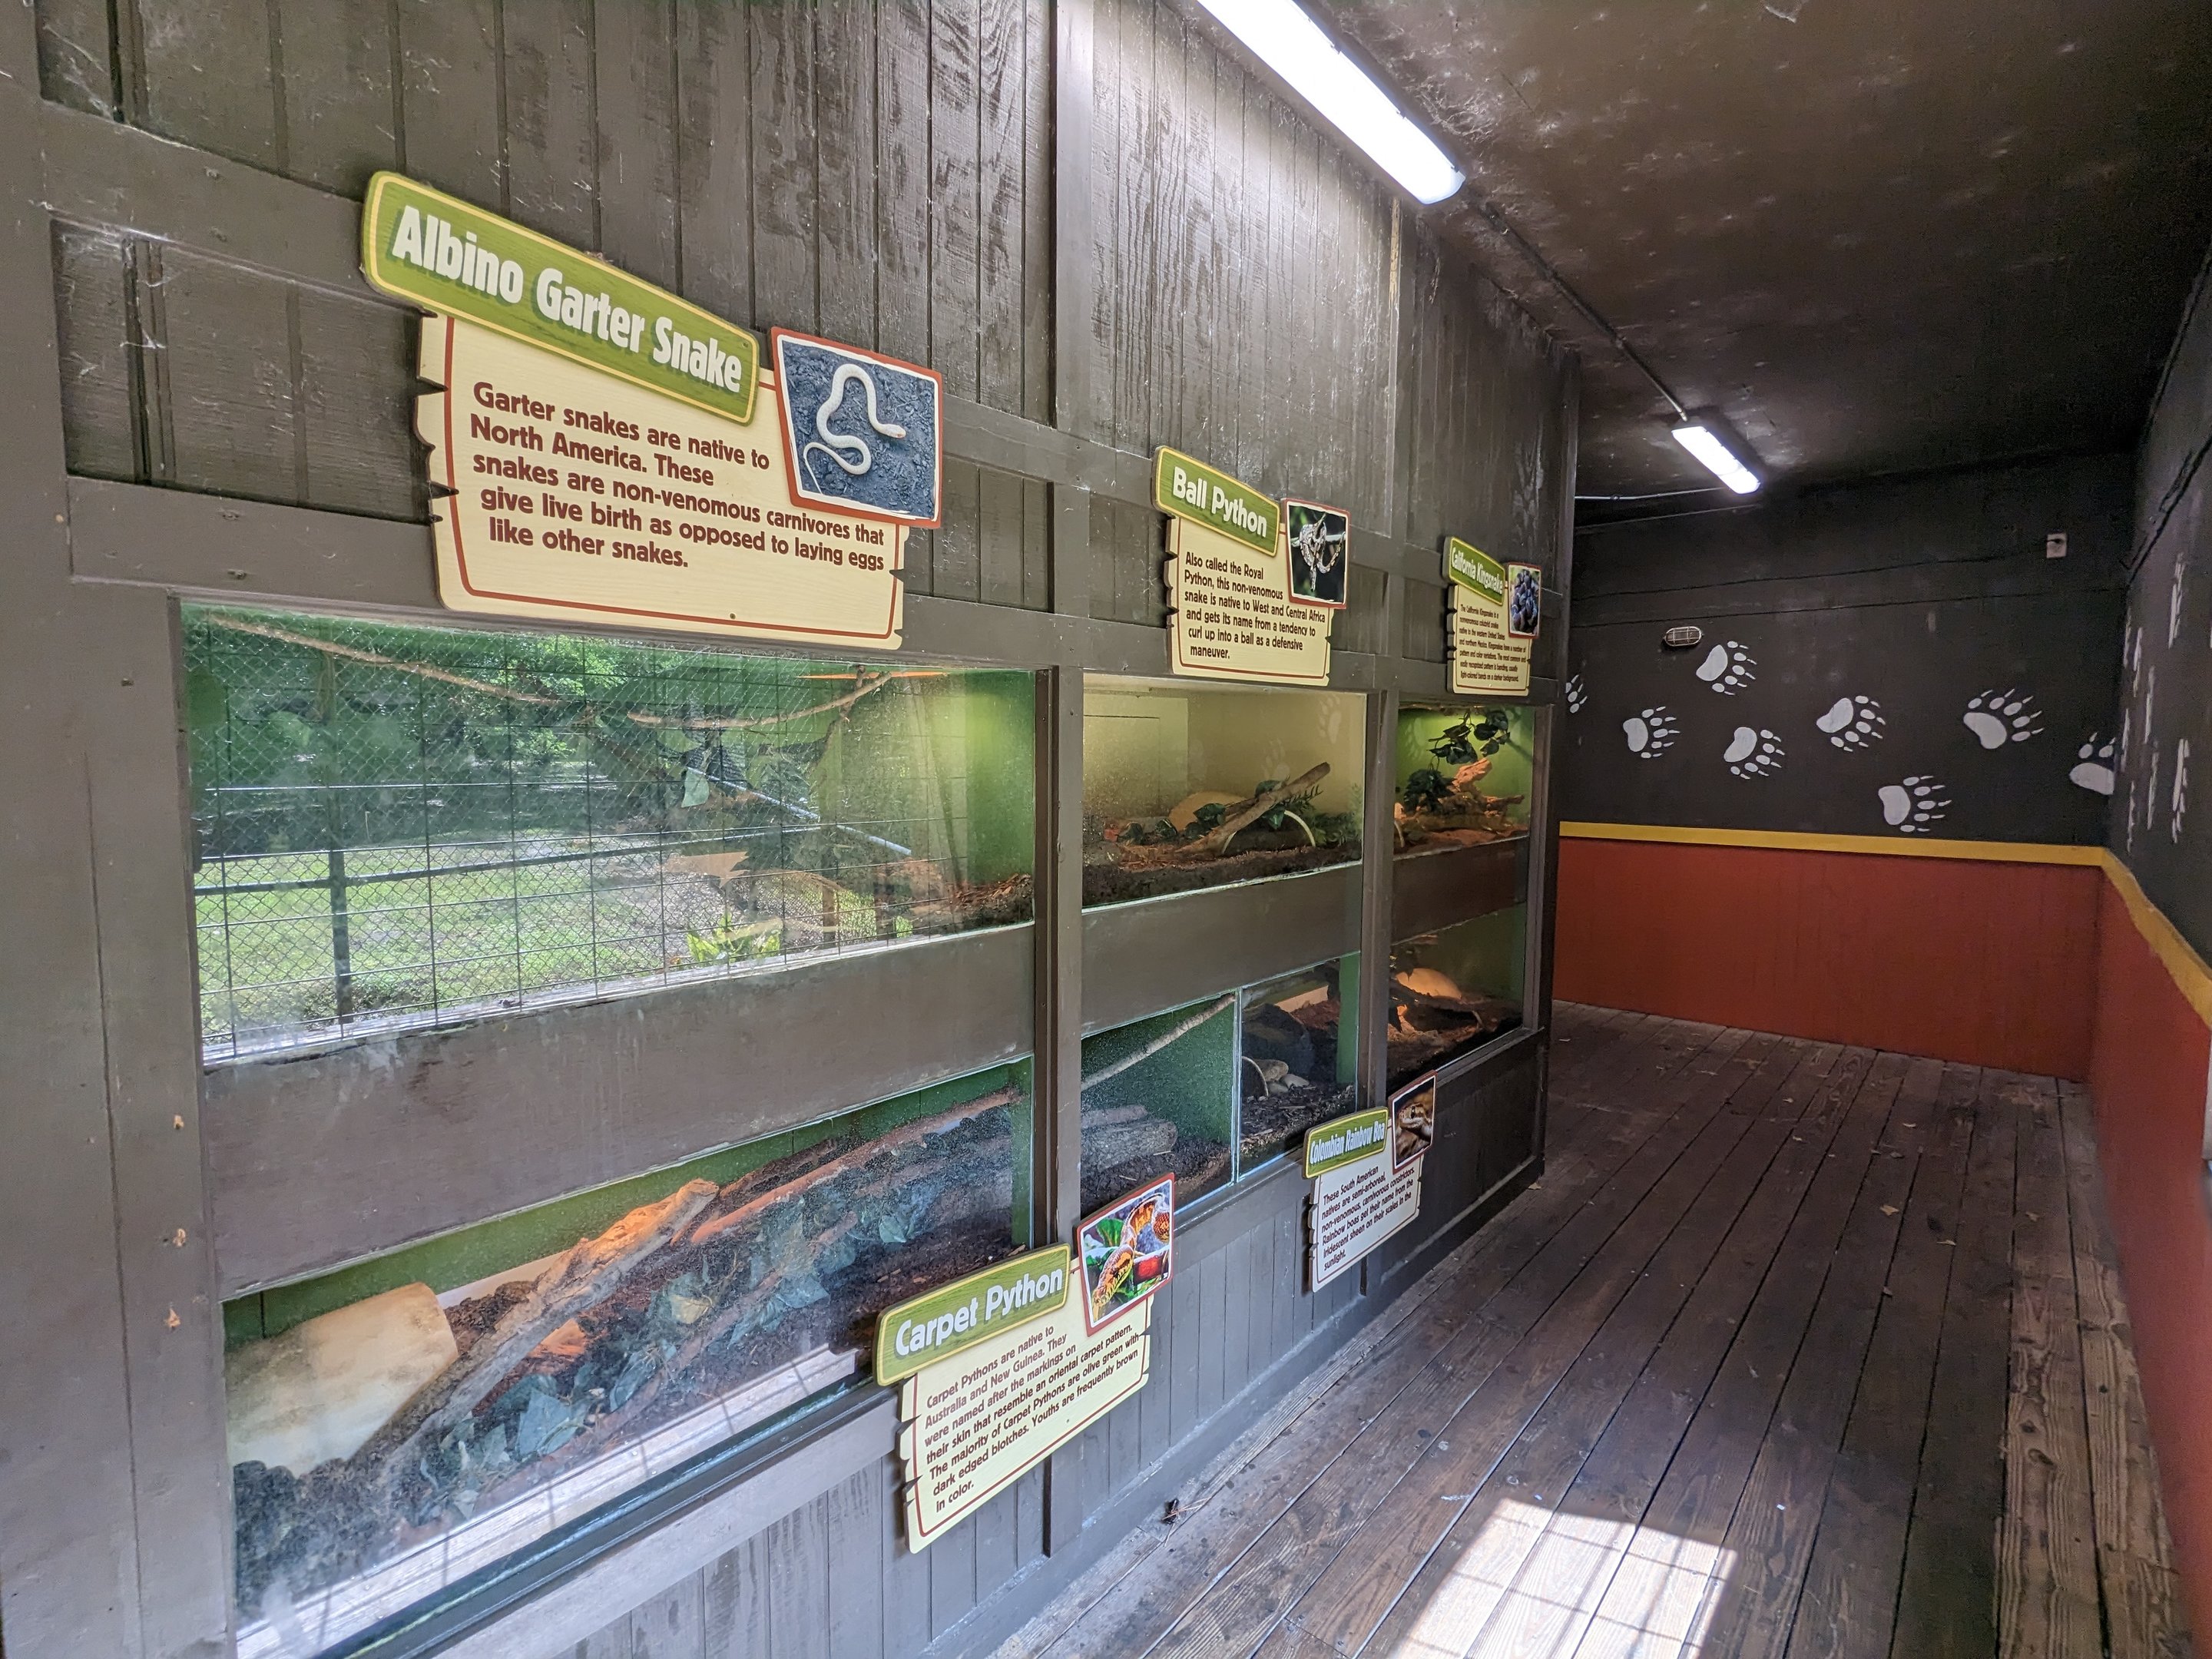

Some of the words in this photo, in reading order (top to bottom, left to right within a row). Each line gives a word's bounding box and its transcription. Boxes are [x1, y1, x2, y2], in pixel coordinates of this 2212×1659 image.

[392, 206, 523, 303] Albino
[537, 268, 645, 353] Garter
[654, 317, 741, 392] Snake
[471, 413, 543, 452] North
[552, 432, 647, 472] America.
[654, 453, 714, 485] These
[474, 382, 555, 421] Garter
[564, 409, 639, 441] snakes
[647, 429, 680, 450] are
[688, 438, 745, 464] native
[751, 449, 769, 469] to
[473, 455, 558, 486] snakes
[568, 472, 604, 495] are
[613, 481, 760, 522] non-venomous
[767, 511, 849, 539] carnivores
[856, 524, 883, 545] that
[1174, 467, 1207, 508] Ball
[1212, 486, 1267, 537] Python
[481, 486, 533, 514] give
[542, 493, 582, 522] live
[591, 502, 641, 531] birth
[650, 518, 672, 535] as
[679, 523, 765, 551] opposed
[771, 535, 789, 555] to
[795, 537, 843, 565] laying
[849, 552, 883, 571] eggs
[490, 517, 533, 545] like
[542, 528, 604, 555] other
[612, 541, 687, 567] snakes.
[1184, 569, 1214, 589] Python,
[1217, 576, 1230, 590] this
[1232, 582, 1283, 600] non-venomous
[1186, 551, 1203, 568] Also
[1206, 558, 1227, 572] called
[1230, 561, 1241, 575] the
[1244, 564, 1263, 579] Royal
[1452, 547, 1476, 580] California
[1476, 562, 1502, 594] Kingsnake
[1185, 590, 1207, 604] snake
[1210, 593, 1216, 605] is
[1219, 596, 1240, 609] native
[1243, 599, 1250, 611] to
[1253, 599, 1269, 614] West
[1271, 604, 1283, 616] and
[1286, 606, 1307, 620] Central
[1309, 610, 1325, 623] Africa
[1187, 608, 1201, 621] and
[1204, 612, 1220, 624] gets
[1233, 617, 1253, 628] name
[1255, 617, 1270, 631] from
[1273, 623, 1277, 631] a
[1280, 622, 1307, 636] tendency
[1310, 626, 1316, 637] to
[1189, 626, 1202, 638] curl
[1205, 630, 1215, 641] up
[1218, 629, 1231, 642] into
[1234, 634, 1238, 643] a
[1241, 631, 1253, 644] ball
[1257, 637, 1263, 646] as
[1272, 636, 1303, 651] defensive
[1190, 646, 1230, 659] maneuver.
[1310, 1134, 1344, 1164] Colombian
[1346, 1126, 1373, 1152] Rainbow
[1373, 1121, 1385, 1142] Boa
[1322, 1202, 1340, 1220] natives
[1342, 1196, 1350, 1207] are
[1322, 1203, 1361, 1233] non-venomous,
[1363, 1184, 1389, 1206] carnivorous
[1323, 1190, 1339, 1205] These
[1341, 1179, 1355, 1194] South
[1356, 1167, 1378, 1185] American
[1323, 1225, 1346, 1246] Rainbow
[1347, 1216, 1359, 1230] boas
[1370, 1200, 1380, 1214] their
[1382, 1192, 1394, 1206] name
[1396, 1184, 1406, 1197] from
[1350, 1224, 1365, 1240] sheen
[1366, 1219, 1373, 1228] on
[1374, 1210, 1384, 1223] their
[1386, 1200, 1398, 1215] scales
[1399, 1197, 1403, 1205] in
[896, 1297, 979, 1356] Carpet
[985, 1268, 1063, 1320] Python
[926, 1396, 966, 1429] Australia
[970, 1379, 987, 1400] and
[991, 1369, 1010, 1388] New
[1013, 1349, 1045, 1373] Guinea.
[1048, 1334, 1067, 1352] They
[927, 1382, 958, 1408] Carpet
[962, 1359, 998, 1389] Pythons
[1001, 1349, 1015, 1364] are
[1018, 1333, 1042, 1354] native
[1045, 1326, 1054, 1337] to
[927, 1443, 949, 1464] their
[952, 1429, 970, 1448] skin
[974, 1414, 991, 1433] that
[994, 1389, 1033, 1420] resemble
[1036, 1380, 1045, 1392] an
[1048, 1356, 1078, 1383] oriental
[1081, 1341, 1103, 1363] carpet
[1106, 1325, 1132, 1348] pattern.
[925, 1426, 949, 1447] were
[952, 1399, 984, 1430] named
[988, 1387, 1008, 1407] after
[1011, 1378, 1024, 1392] the
[1028, 1353, 1063, 1382] markings
[1066, 1345, 1075, 1356] on
[930, 1462, 948, 1480] The
[952, 1434, 988, 1466] majority
[992, 1422, 1001, 1438] of
[1004, 1405, 1031, 1429] Carpet
[1034, 1383, 1065, 1410] Pythons
[1068, 1373, 1080, 1387] are
[1083, 1360, 1100, 1376] olive
[1102, 1344, 1123, 1365] green
[1124, 1333, 1139, 1348] with
[933, 1473, 955, 1495] dark
[959, 1449, 988, 1478] edged
[992, 1426, 1028, 1455] blotches.
[1031, 1403, 1059, 1426] Youths
[1062, 1393, 1075, 1406] are
[1077, 1366, 1114, 1396] frequently
[1116, 1349, 1138, 1369] brown
[937, 1500, 945, 1512] in
[949, 1481, 974, 1503] color.
